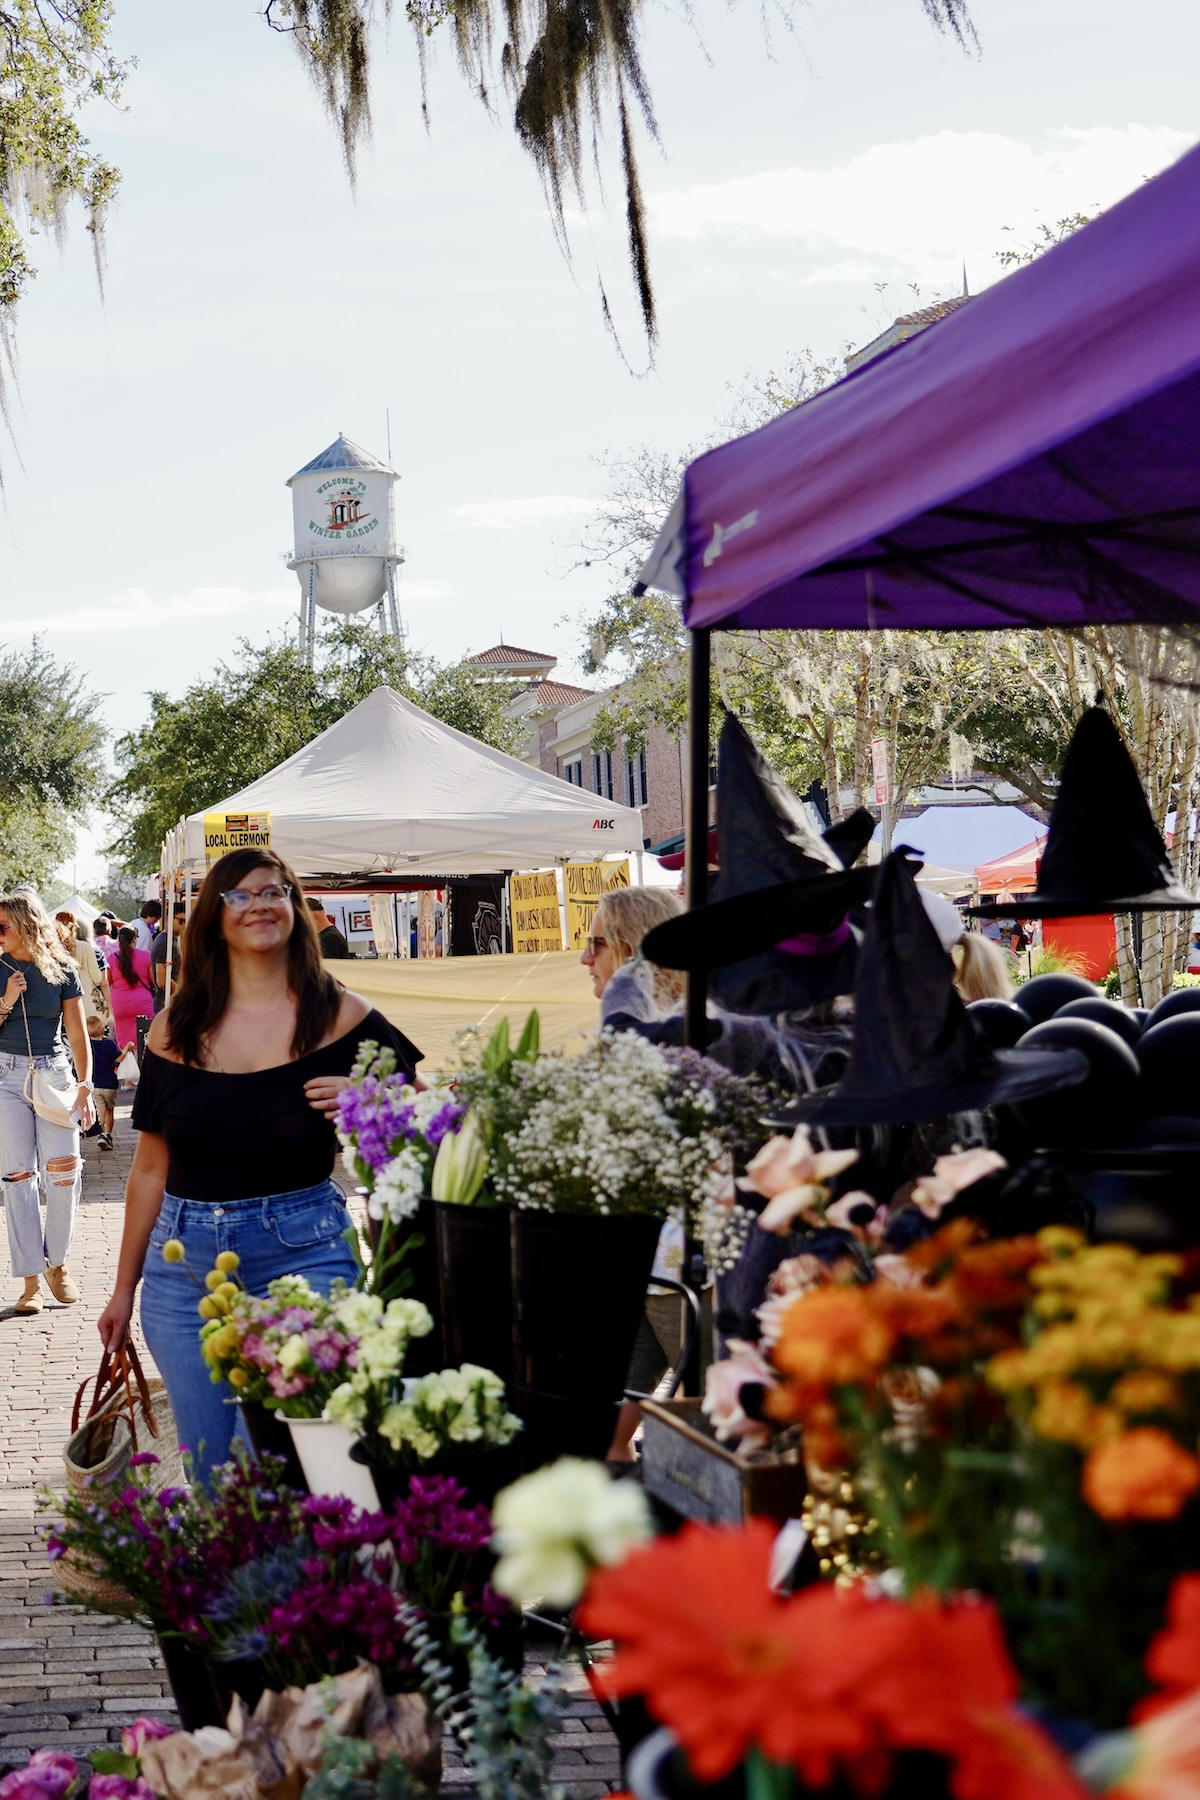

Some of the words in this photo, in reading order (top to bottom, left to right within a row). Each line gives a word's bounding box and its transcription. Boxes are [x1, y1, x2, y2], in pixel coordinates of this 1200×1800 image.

[316, 477, 355, 494] WELCOME
[357, 481, 367, 491] TO
[308, 520, 341, 539] WINTER
[346, 518, 379, 539] GARDEN
[592, 819, 615, 829] ABC
[205, 834, 228, 848] LOCAL
[230, 832, 270, 847] CLERMONT
